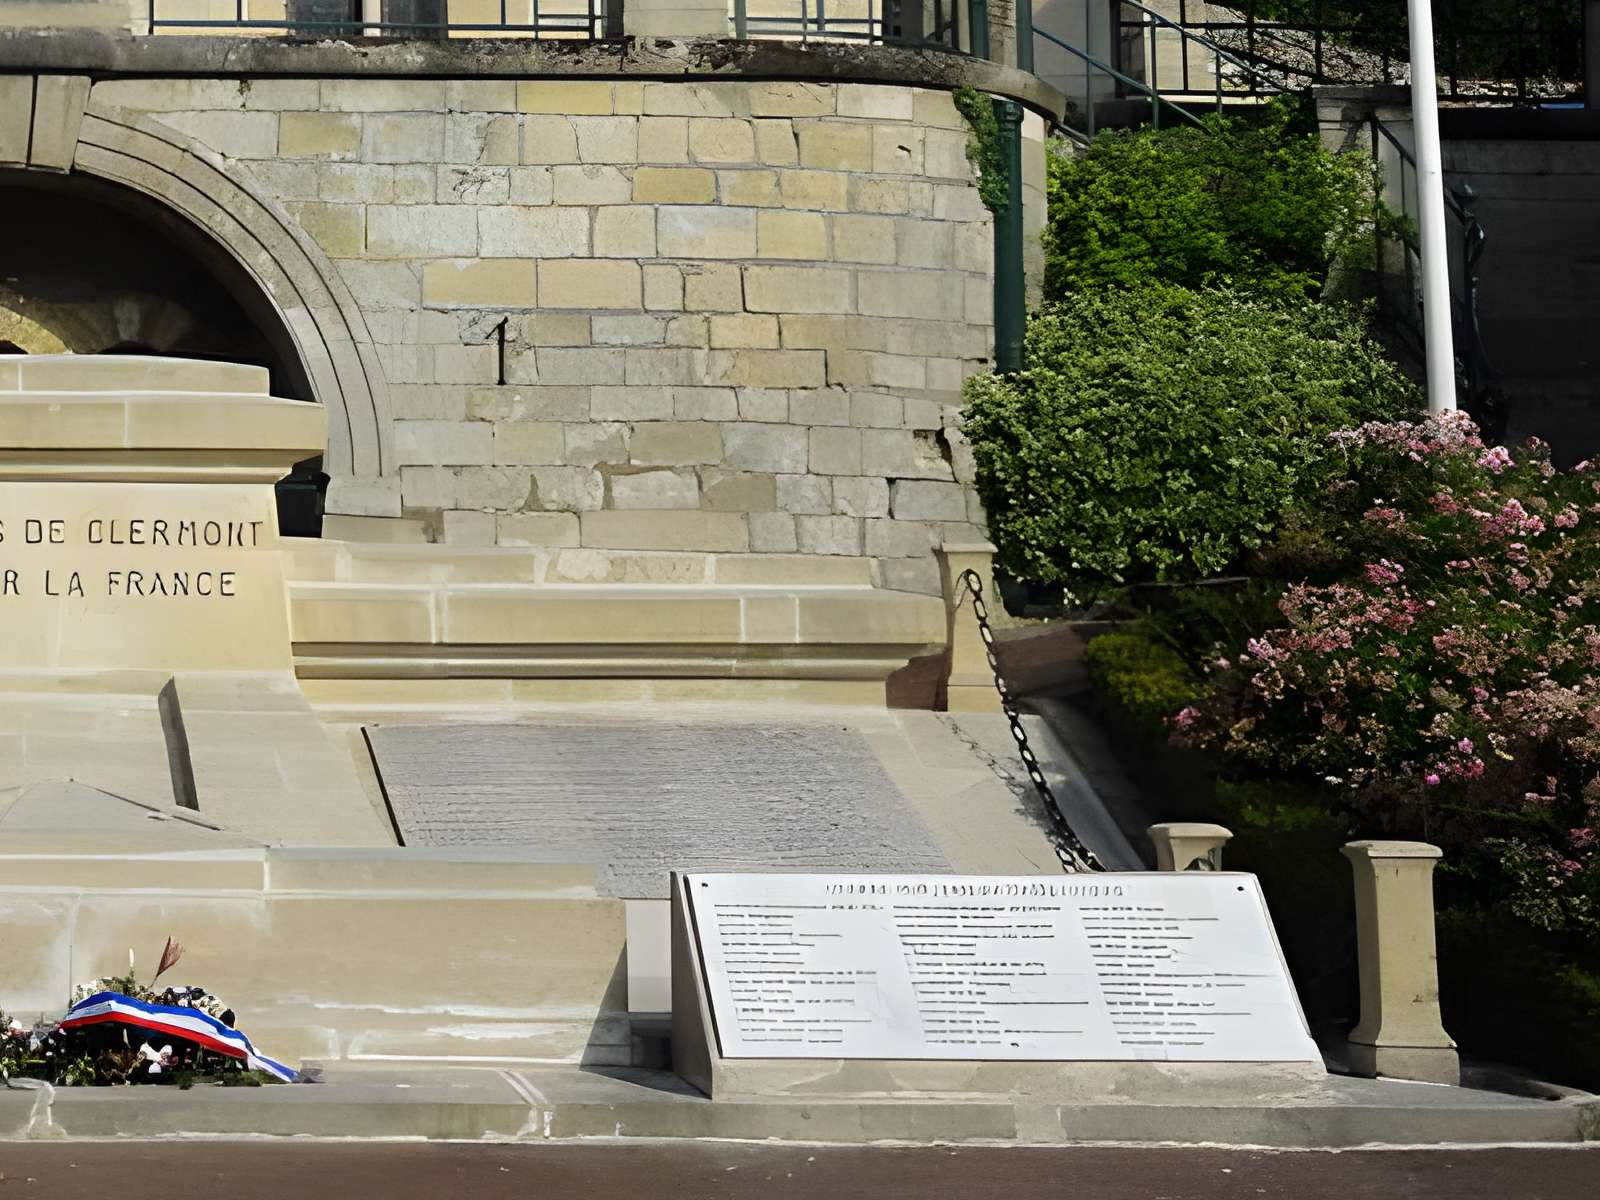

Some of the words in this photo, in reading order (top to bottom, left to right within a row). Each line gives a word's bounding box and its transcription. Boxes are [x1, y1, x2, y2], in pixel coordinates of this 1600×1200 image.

[23, 518, 65, 545] DE
[86, 518, 264, 548] CLERMONT
[44, 569, 85, 598] LA
[106, 570, 236, 598] FRANCE
